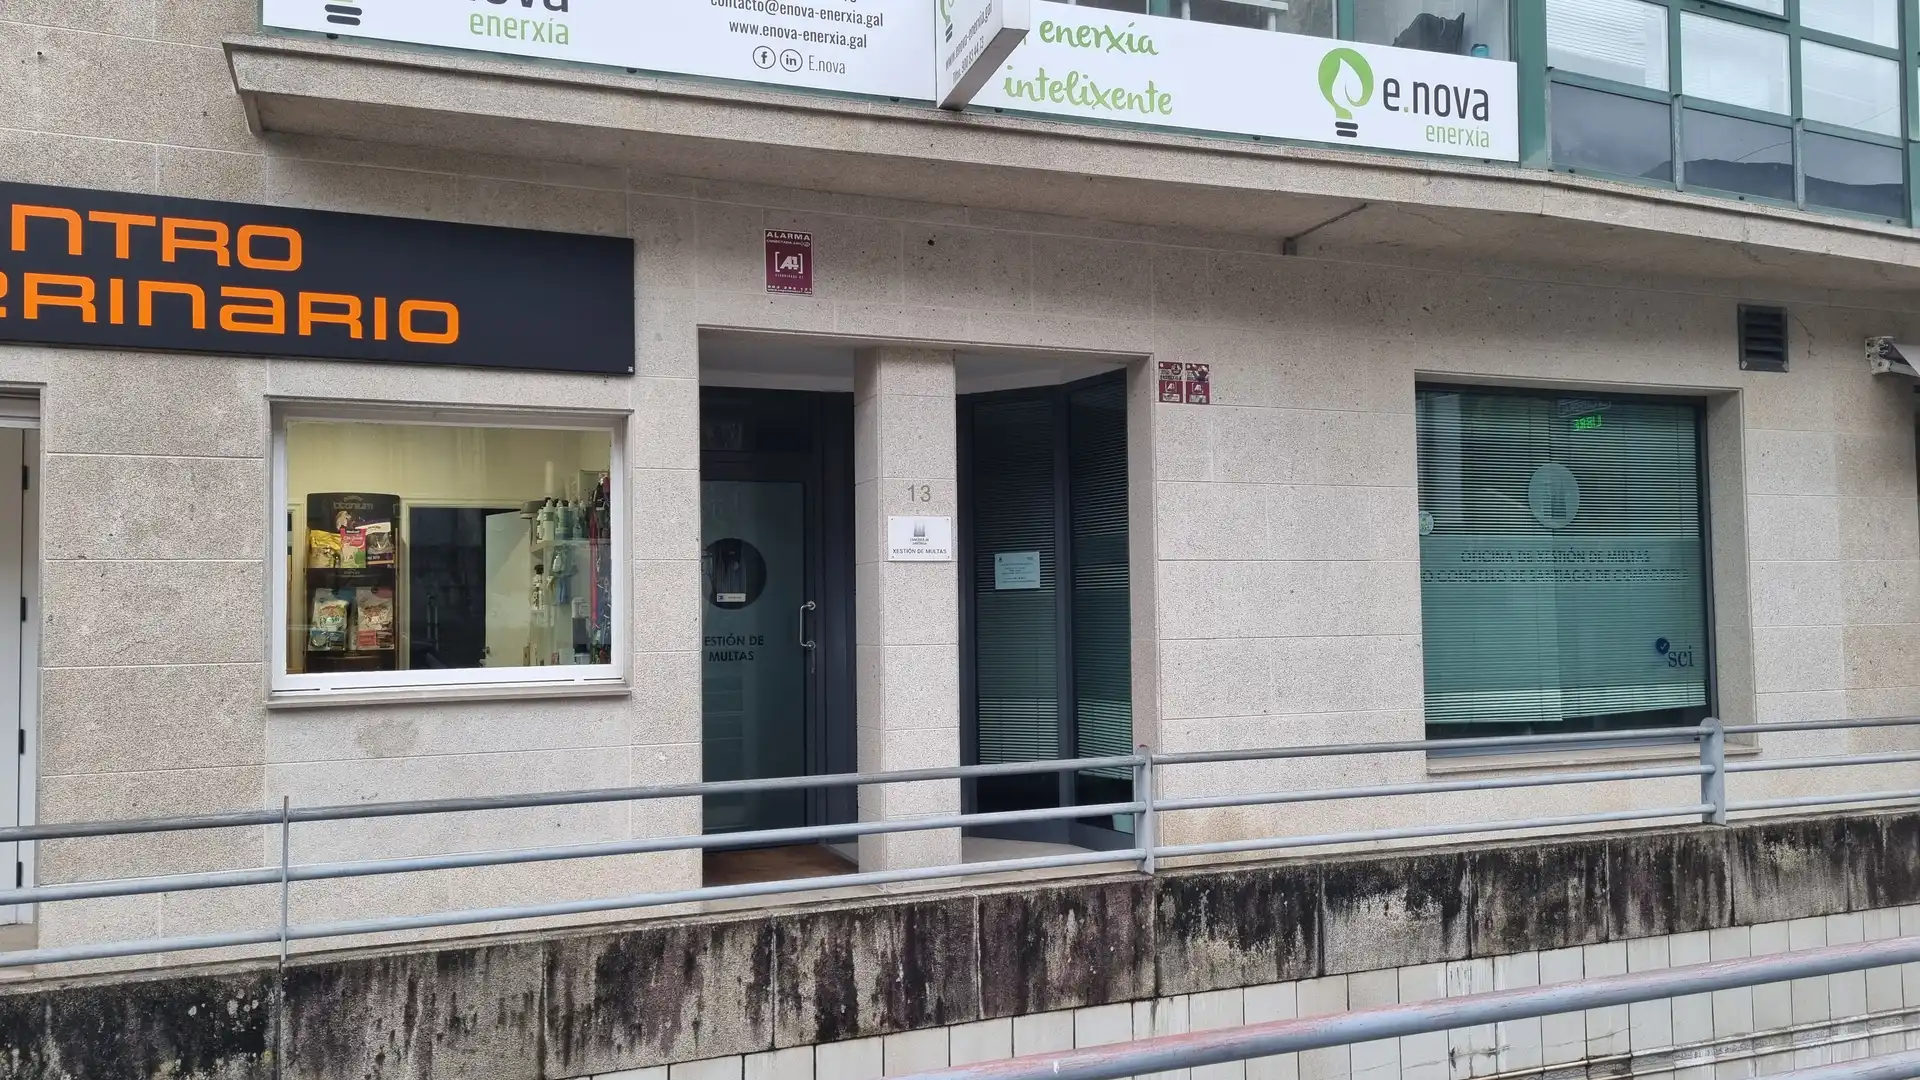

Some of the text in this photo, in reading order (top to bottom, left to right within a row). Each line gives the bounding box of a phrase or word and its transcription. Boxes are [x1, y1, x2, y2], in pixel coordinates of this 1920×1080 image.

[469, 12, 569, 45] enerxía
[729, 21, 867, 50] www.enova-enerxia.gal
[1039, 20, 1159, 56] enerxía
[808, 54, 846, 74] E.nova
[1003, 64, 1173, 116] intelixente
[1382, 77, 1489, 122] e.nova
[1425, 124, 1490, 149] enerxía
[766, 231, 811, 241] ALARMA
[907, 484, 931, 502] 13
[1461, 549, 1515, 562] OFICINA
[1518, 549, 1533, 562] DE
[1589, 549, 1604, 562] DE
[1607, 549, 1650, 562] MULTAS
[1437, 569, 1507, 582] CONCELLO
[1511, 569, 1526, 582] DE
[1530, 569, 1592, 582] SANTIAGO
[1595, 569, 1610, 581] DE
[1615, 567, 1688, 581] COMPOSTELA
[748, 634, 764, 646] DE
[709, 650, 754, 661] MULTAS
[1668, 644, 1694, 668] sci
